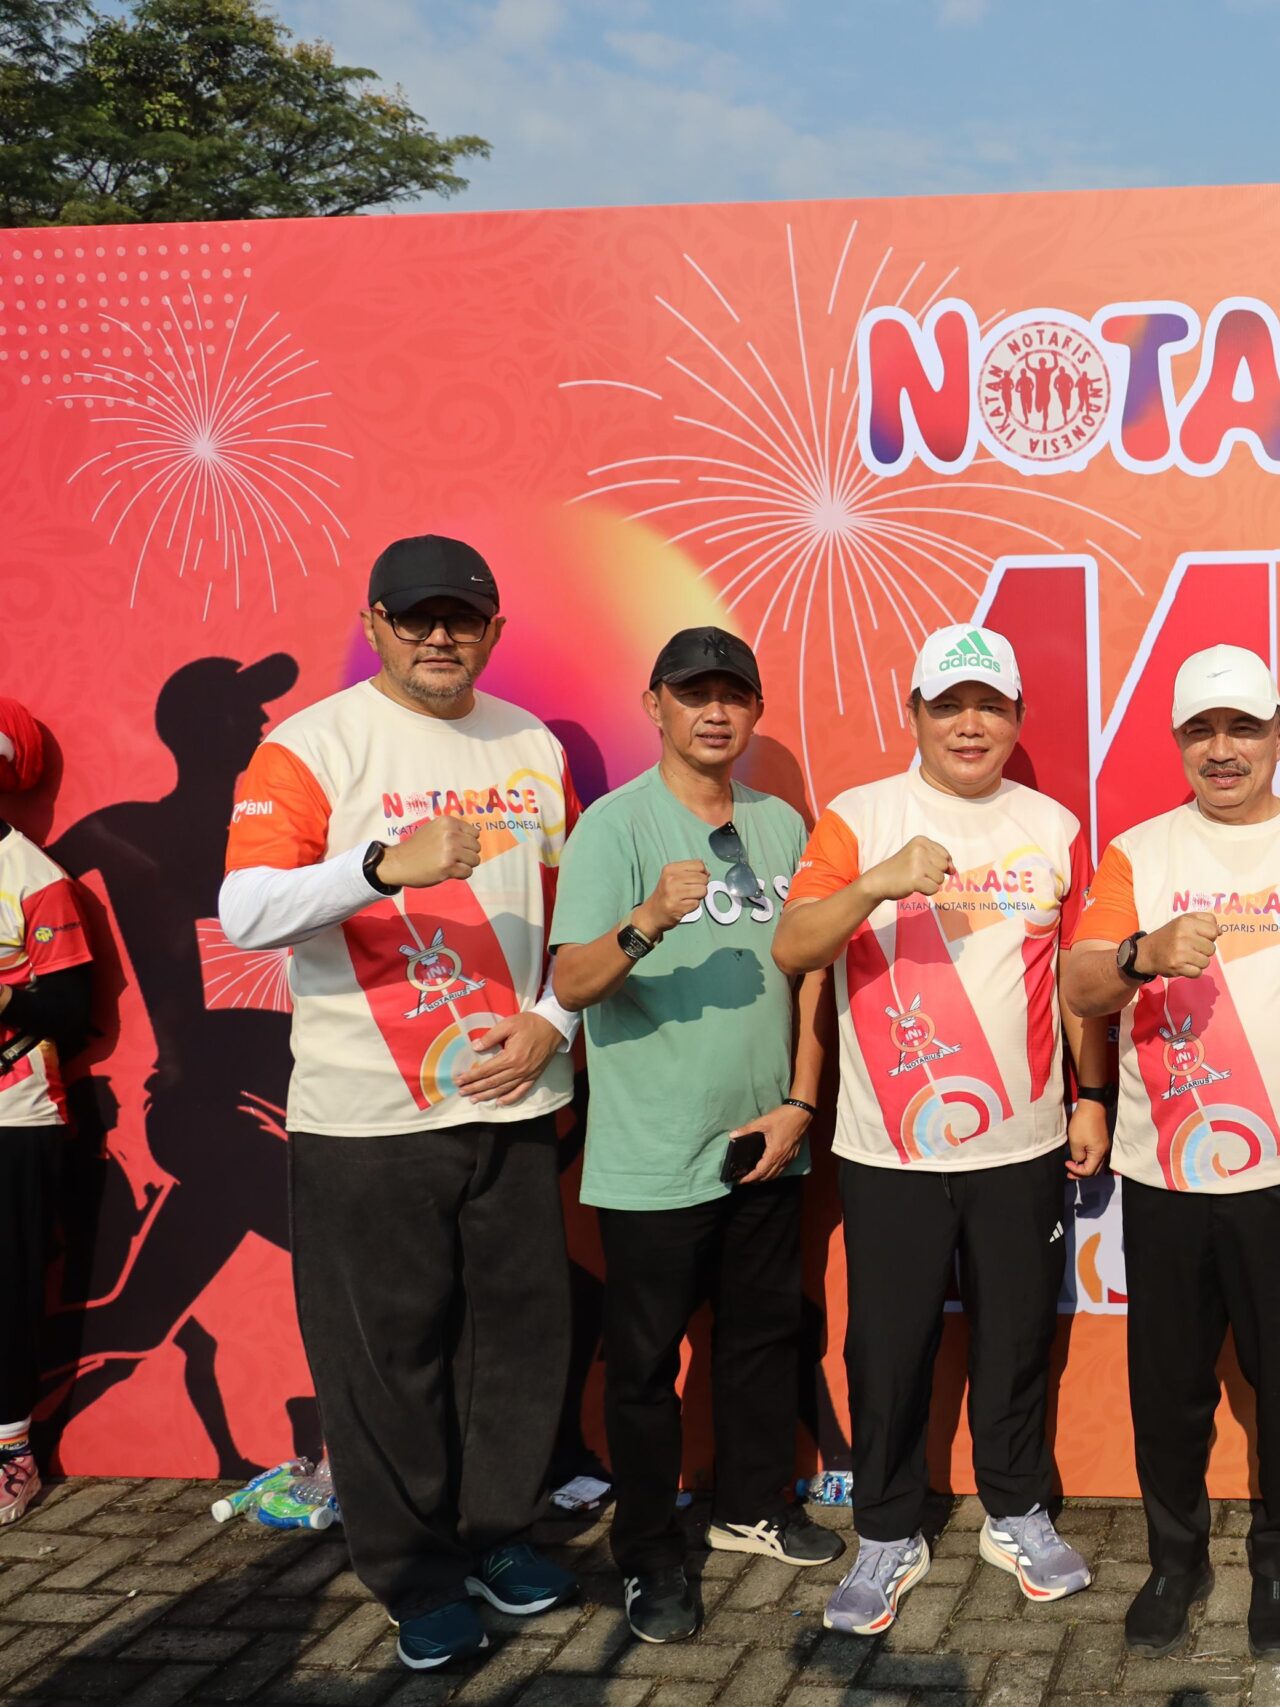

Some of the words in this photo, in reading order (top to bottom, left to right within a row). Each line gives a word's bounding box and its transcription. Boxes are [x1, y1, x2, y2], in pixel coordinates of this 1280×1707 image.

[1007, 329, 1091, 364] NOTARIS
[983, 364, 1018, 442] IKATAN
[1029, 377, 1103, 455] INDONESIA
[939, 654, 1001, 672] adidas
[245, 800, 272, 815] BNI
[486, 820, 542, 831] INDONESIA
[935, 902, 976, 911] NOTARIS
[980, 902, 1036, 911] INDONESIA
[1217, 924, 1255, 933] OTARIS
[426, 966, 448, 980] INI
[428, 990, 468, 1010] NOTARIUS
[905, 1028, 923, 1041] INI
[906, 1053, 942, 1069] NOTARIUS
[1175, 1051, 1191, 1064] INI
[1176, 1077, 1210, 1094] NOTARIUS
